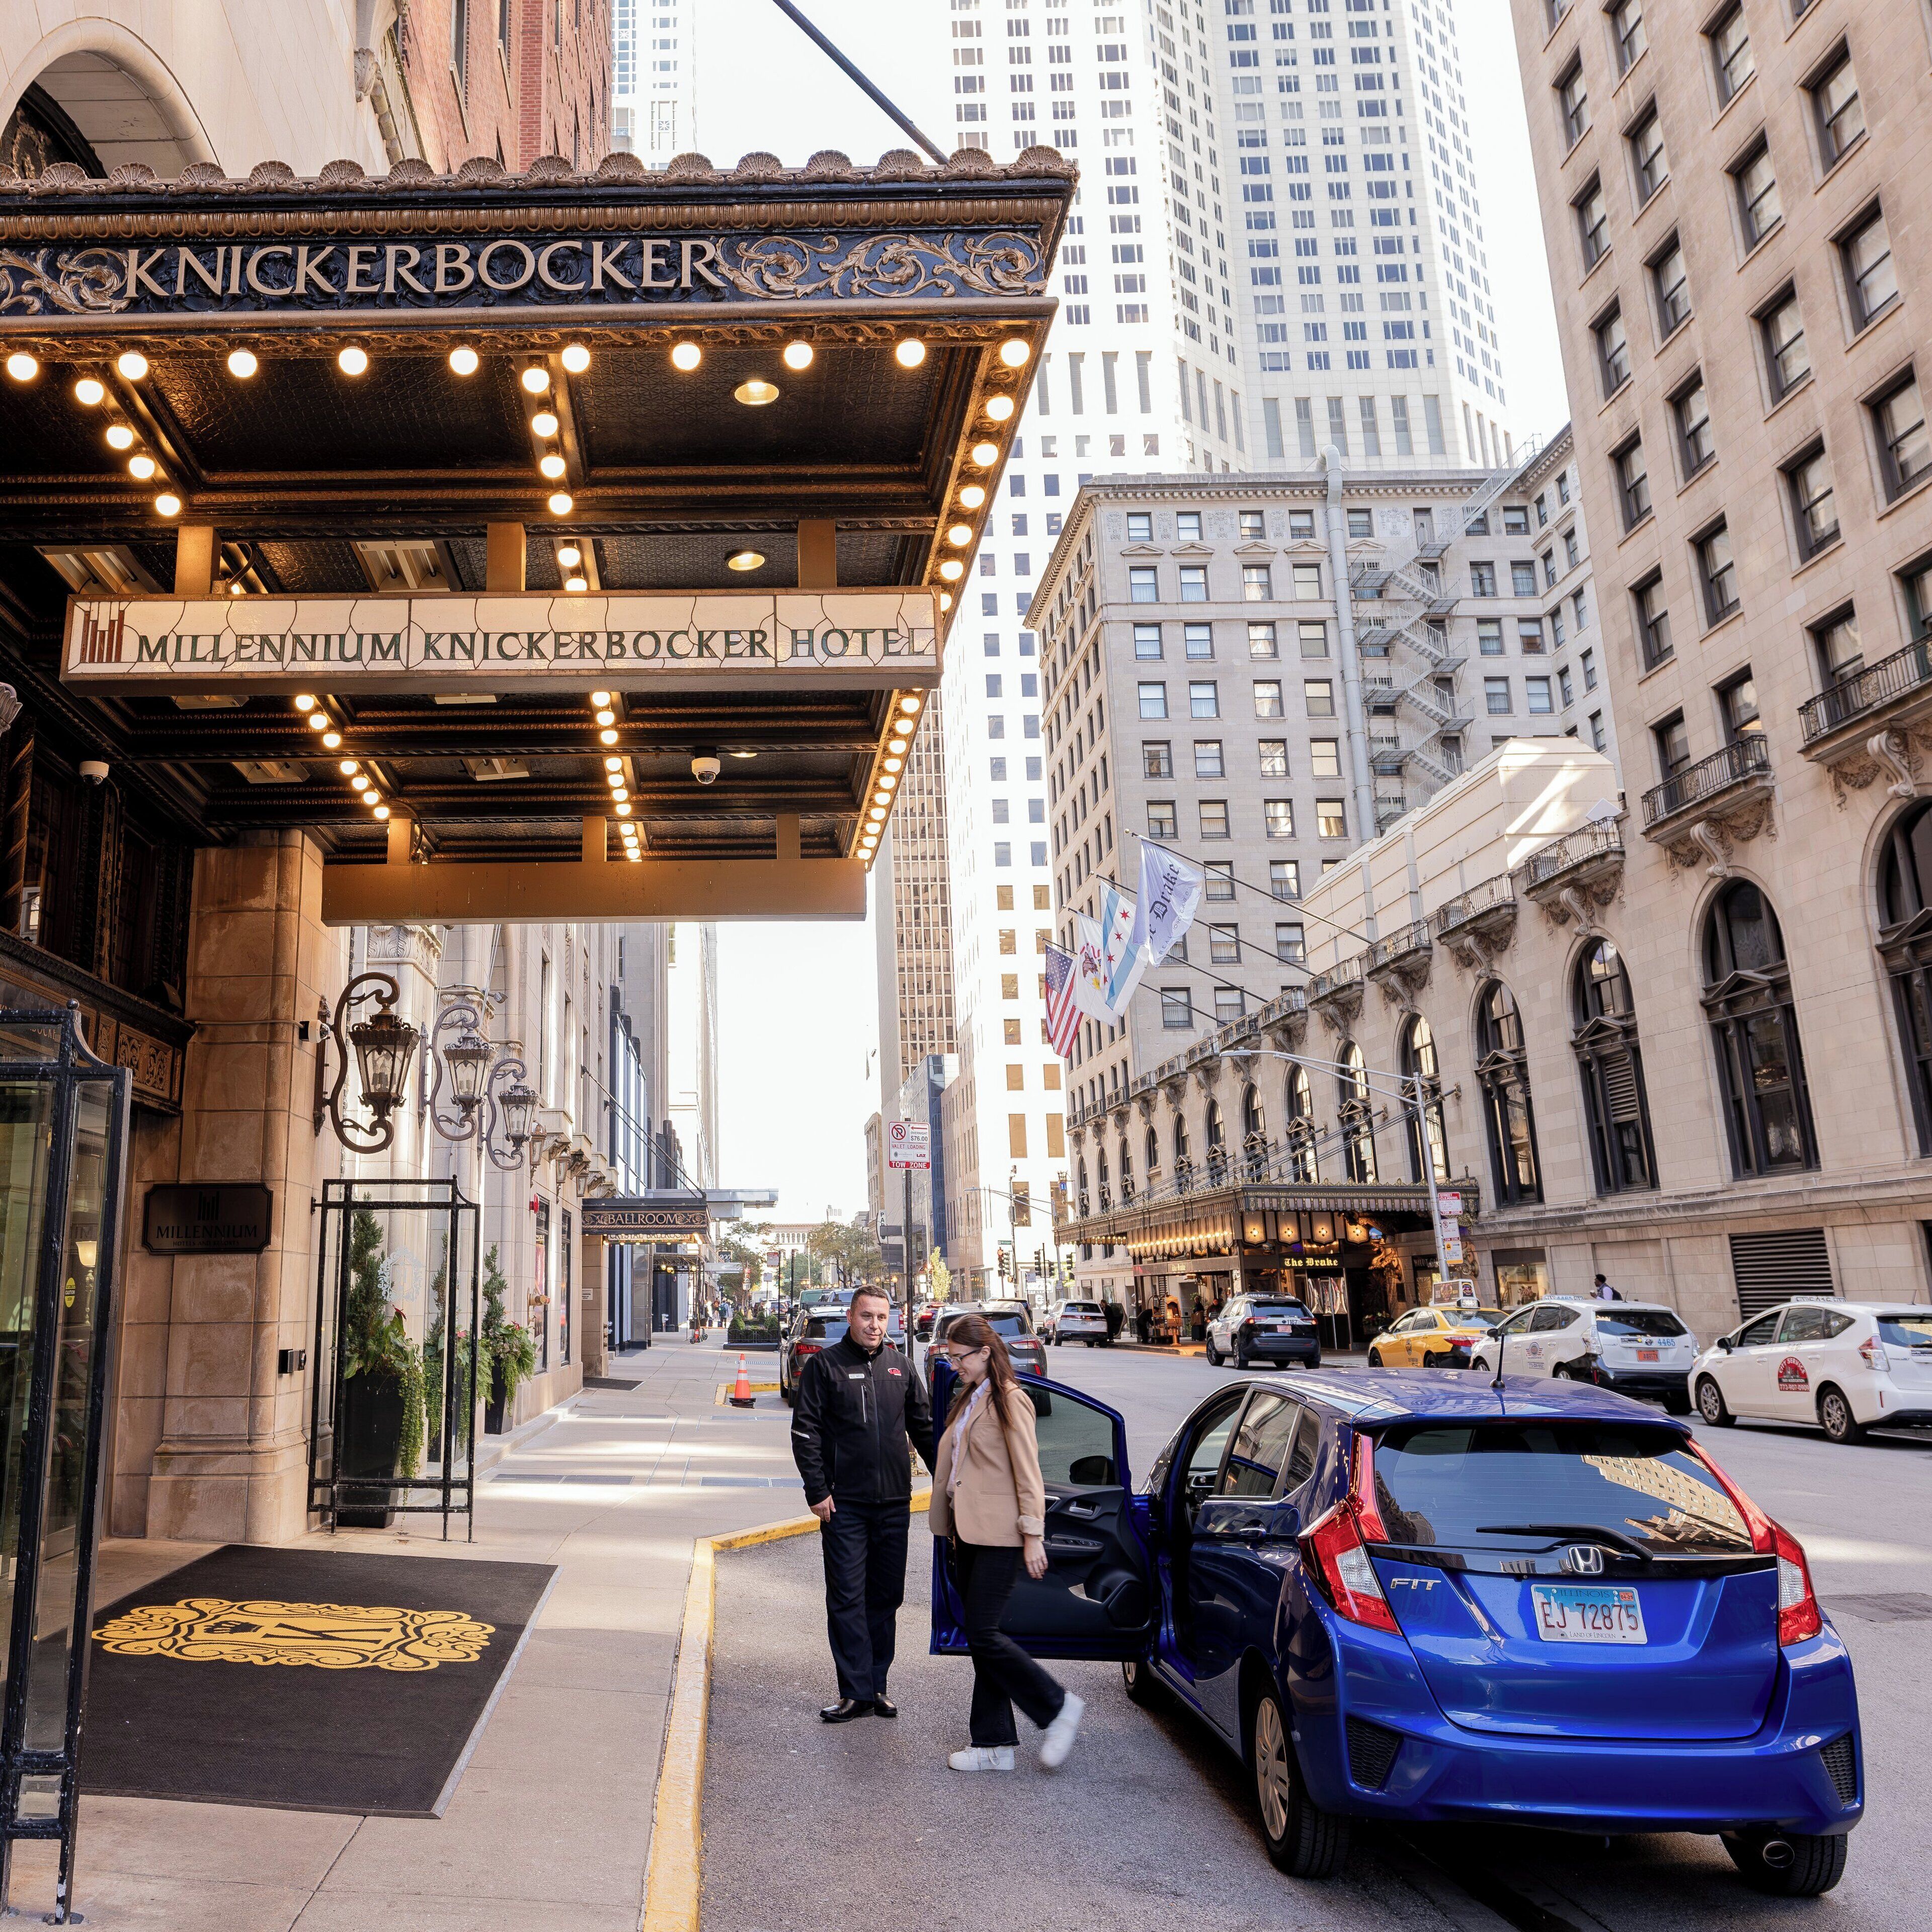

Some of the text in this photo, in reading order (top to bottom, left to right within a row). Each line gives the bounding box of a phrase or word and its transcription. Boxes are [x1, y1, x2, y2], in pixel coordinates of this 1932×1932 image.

[123, 239, 728, 298] KNICKERBOCKER
[138, 628, 931, 662] MILLENNIUM KNICKERBOCKER HOTEL
[1150, 864, 1180, 923] Drake
[608, 1213, 679, 1224] BALLROOM
[156, 1225, 257, 1239] MILLENNIUM
[1284, 1257, 1338, 1266] The Drake
[1787, 1358, 1806, 1374] SERVICE
[1390, 1578, 1442, 1591] FIT
[1561, 1589, 1610, 1597] ILLINOIS
[1541, 1602, 1639, 1630] EJ 72875
